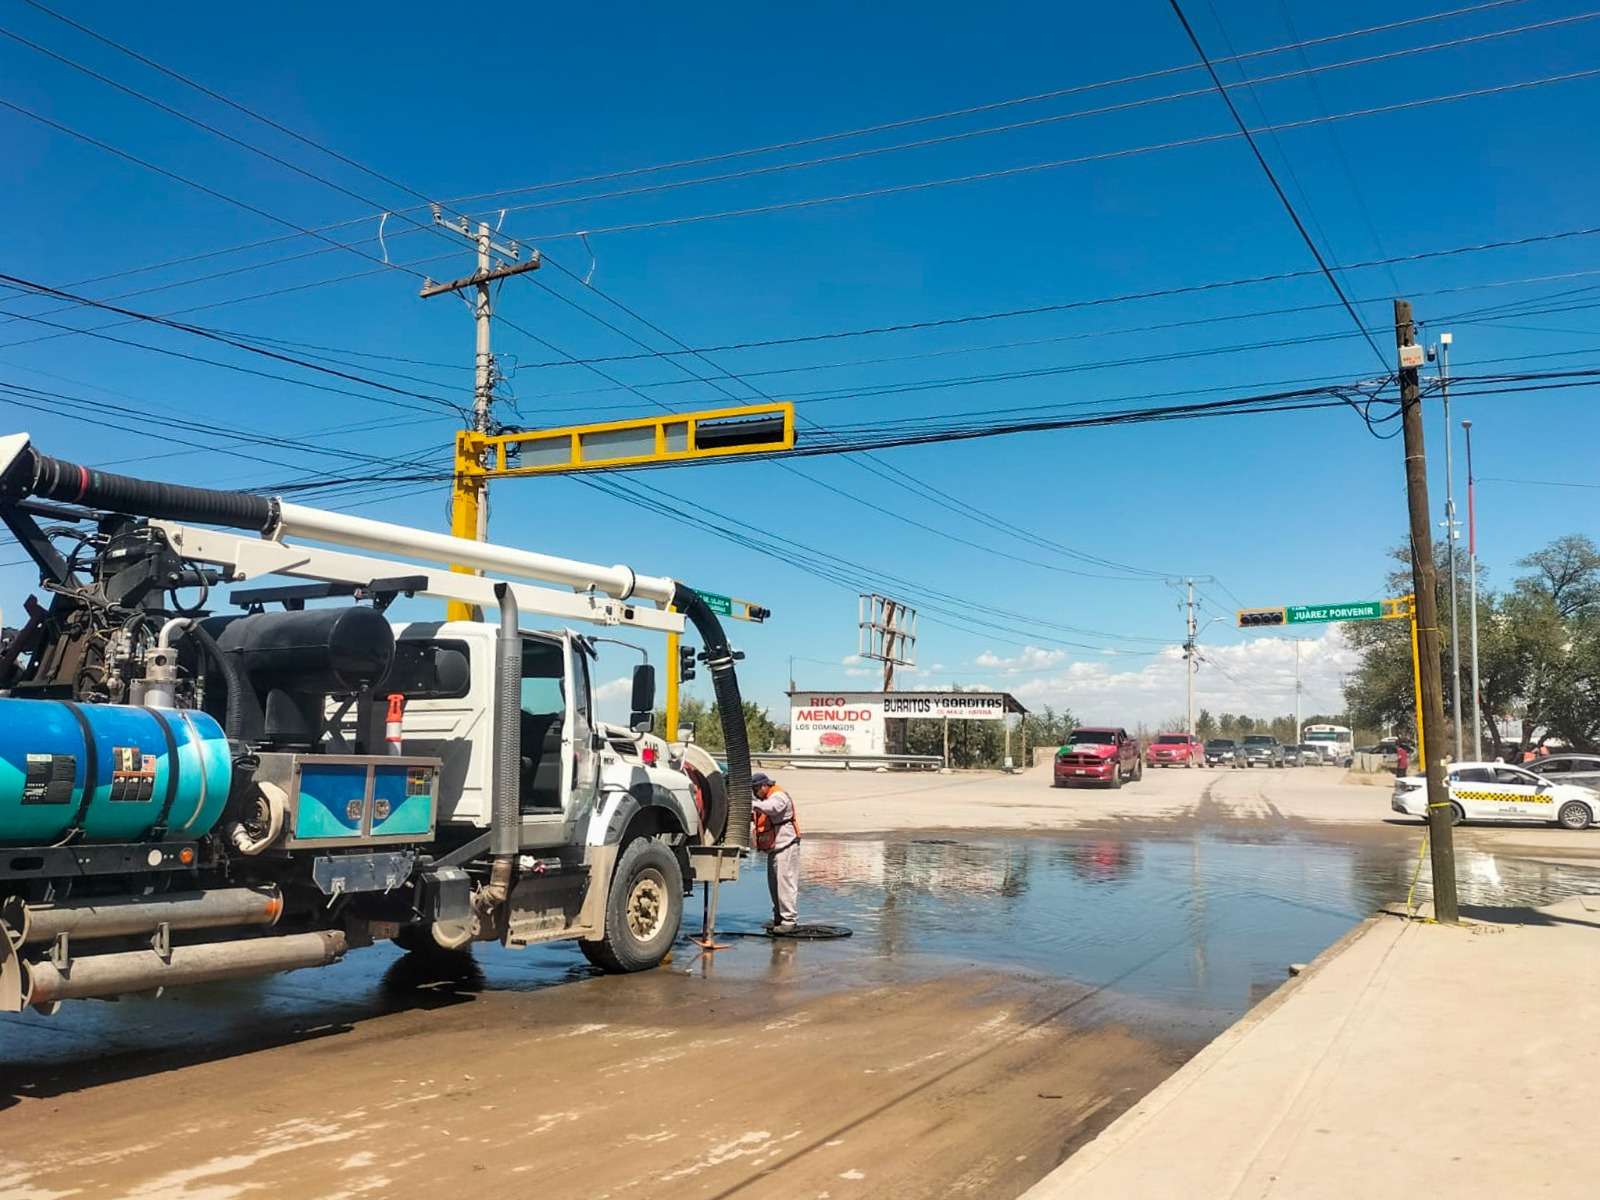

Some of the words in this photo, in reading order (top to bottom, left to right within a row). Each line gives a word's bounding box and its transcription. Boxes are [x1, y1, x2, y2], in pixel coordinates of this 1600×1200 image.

[1329, 606, 1374, 617] PORVENIR
[810, 697, 846, 707] RICO
[884, 698, 930, 713] BURRITOS
[934, 698, 941, 708] Y
[942, 698, 1002, 708] GORDITAS
[797, 710, 872, 721] MENUDO
[812, 723, 855, 732] DOMINGOS
[1520, 794, 1535, 803] TAXI
